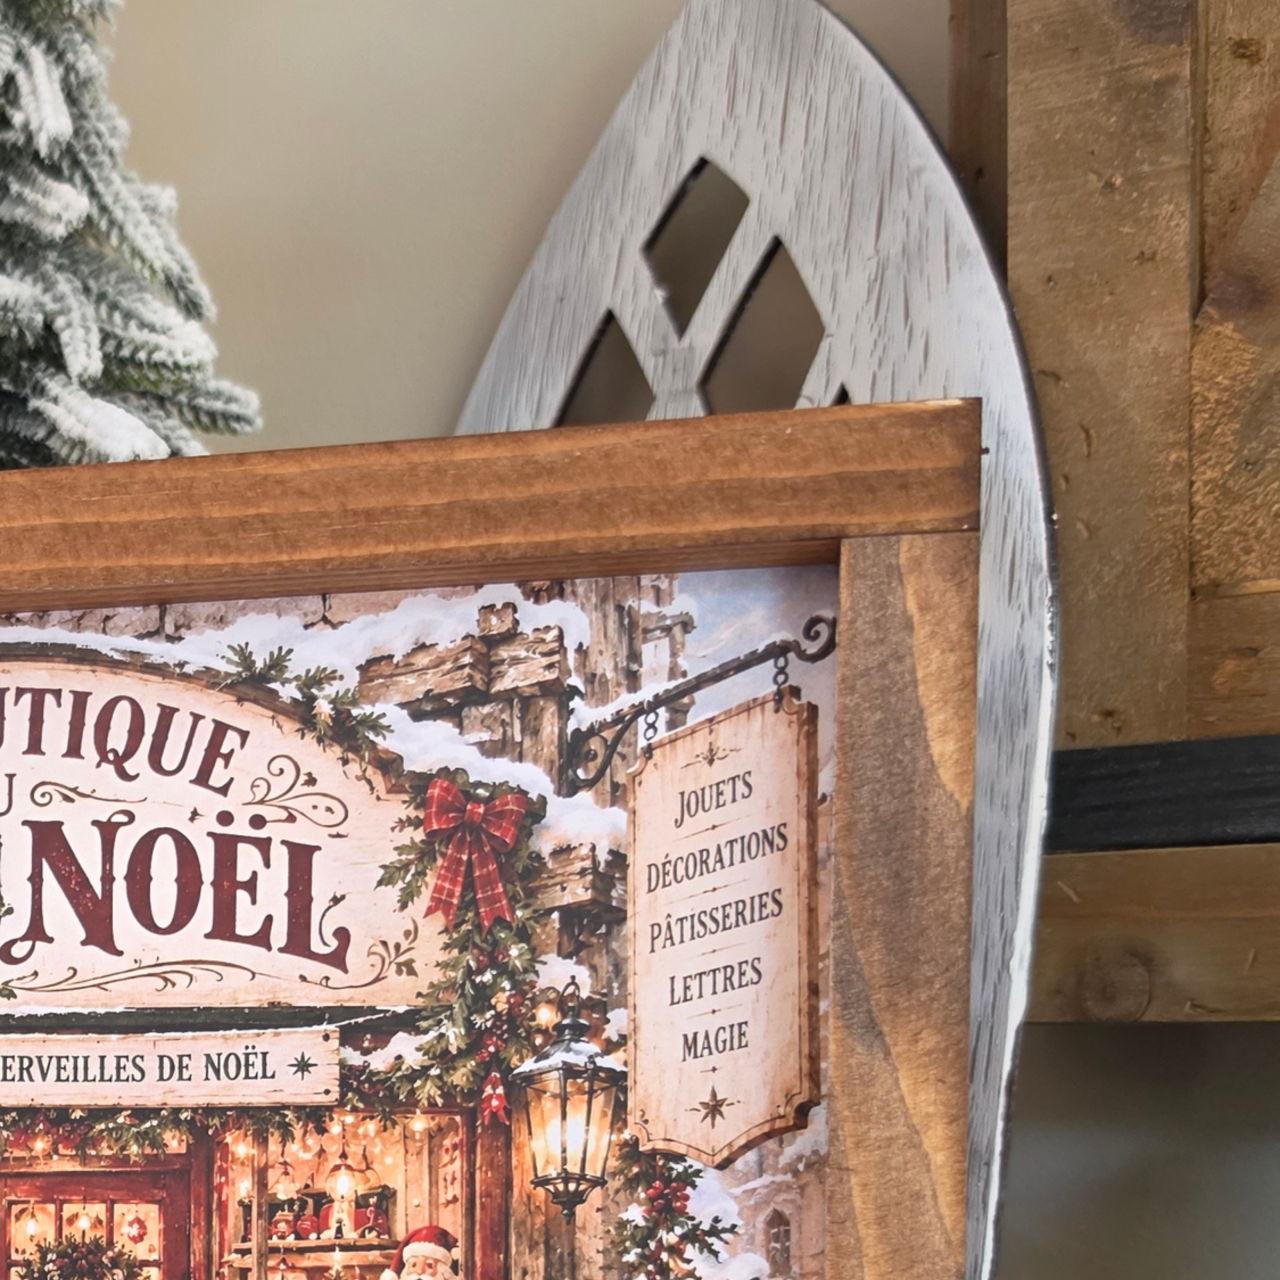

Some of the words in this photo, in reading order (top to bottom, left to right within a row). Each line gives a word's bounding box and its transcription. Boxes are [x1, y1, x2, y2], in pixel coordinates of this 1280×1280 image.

[674, 770, 753, 828] JOUETS
[646, 822, 789, 894] DÉCORATIONS
[0, 808, 351, 974] NOËL
[649, 888, 784, 953] PÂTISSERIES
[668, 957, 763, 1006] LETTRES
[157, 1054, 194, 1082] DE
[204, 1046, 276, 1082] NOËL
[681, 1020, 750, 1062] MAGIE
